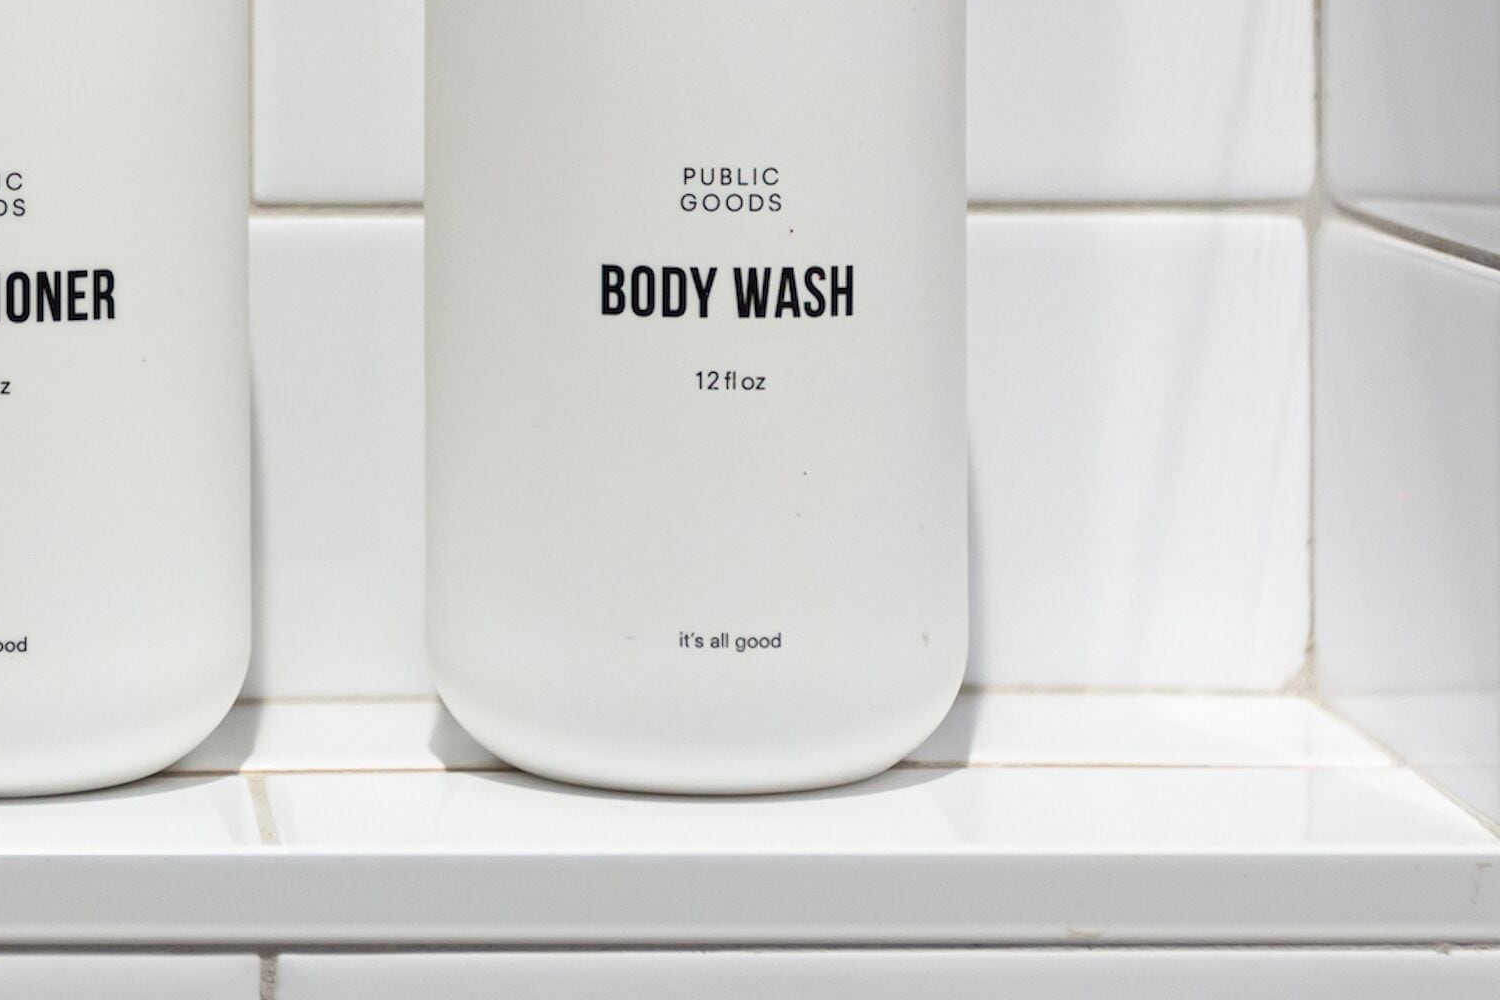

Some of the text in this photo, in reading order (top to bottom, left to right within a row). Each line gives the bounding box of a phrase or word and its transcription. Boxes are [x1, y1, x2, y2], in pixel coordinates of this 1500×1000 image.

[683, 166, 779, 187] PUBLIC
[680, 192, 782, 213] GOODS
[600, 263, 854, 320] BODY WASH
[695, 370, 766, 391] 12 fl oz
[679, 631, 782, 653] it's all good
